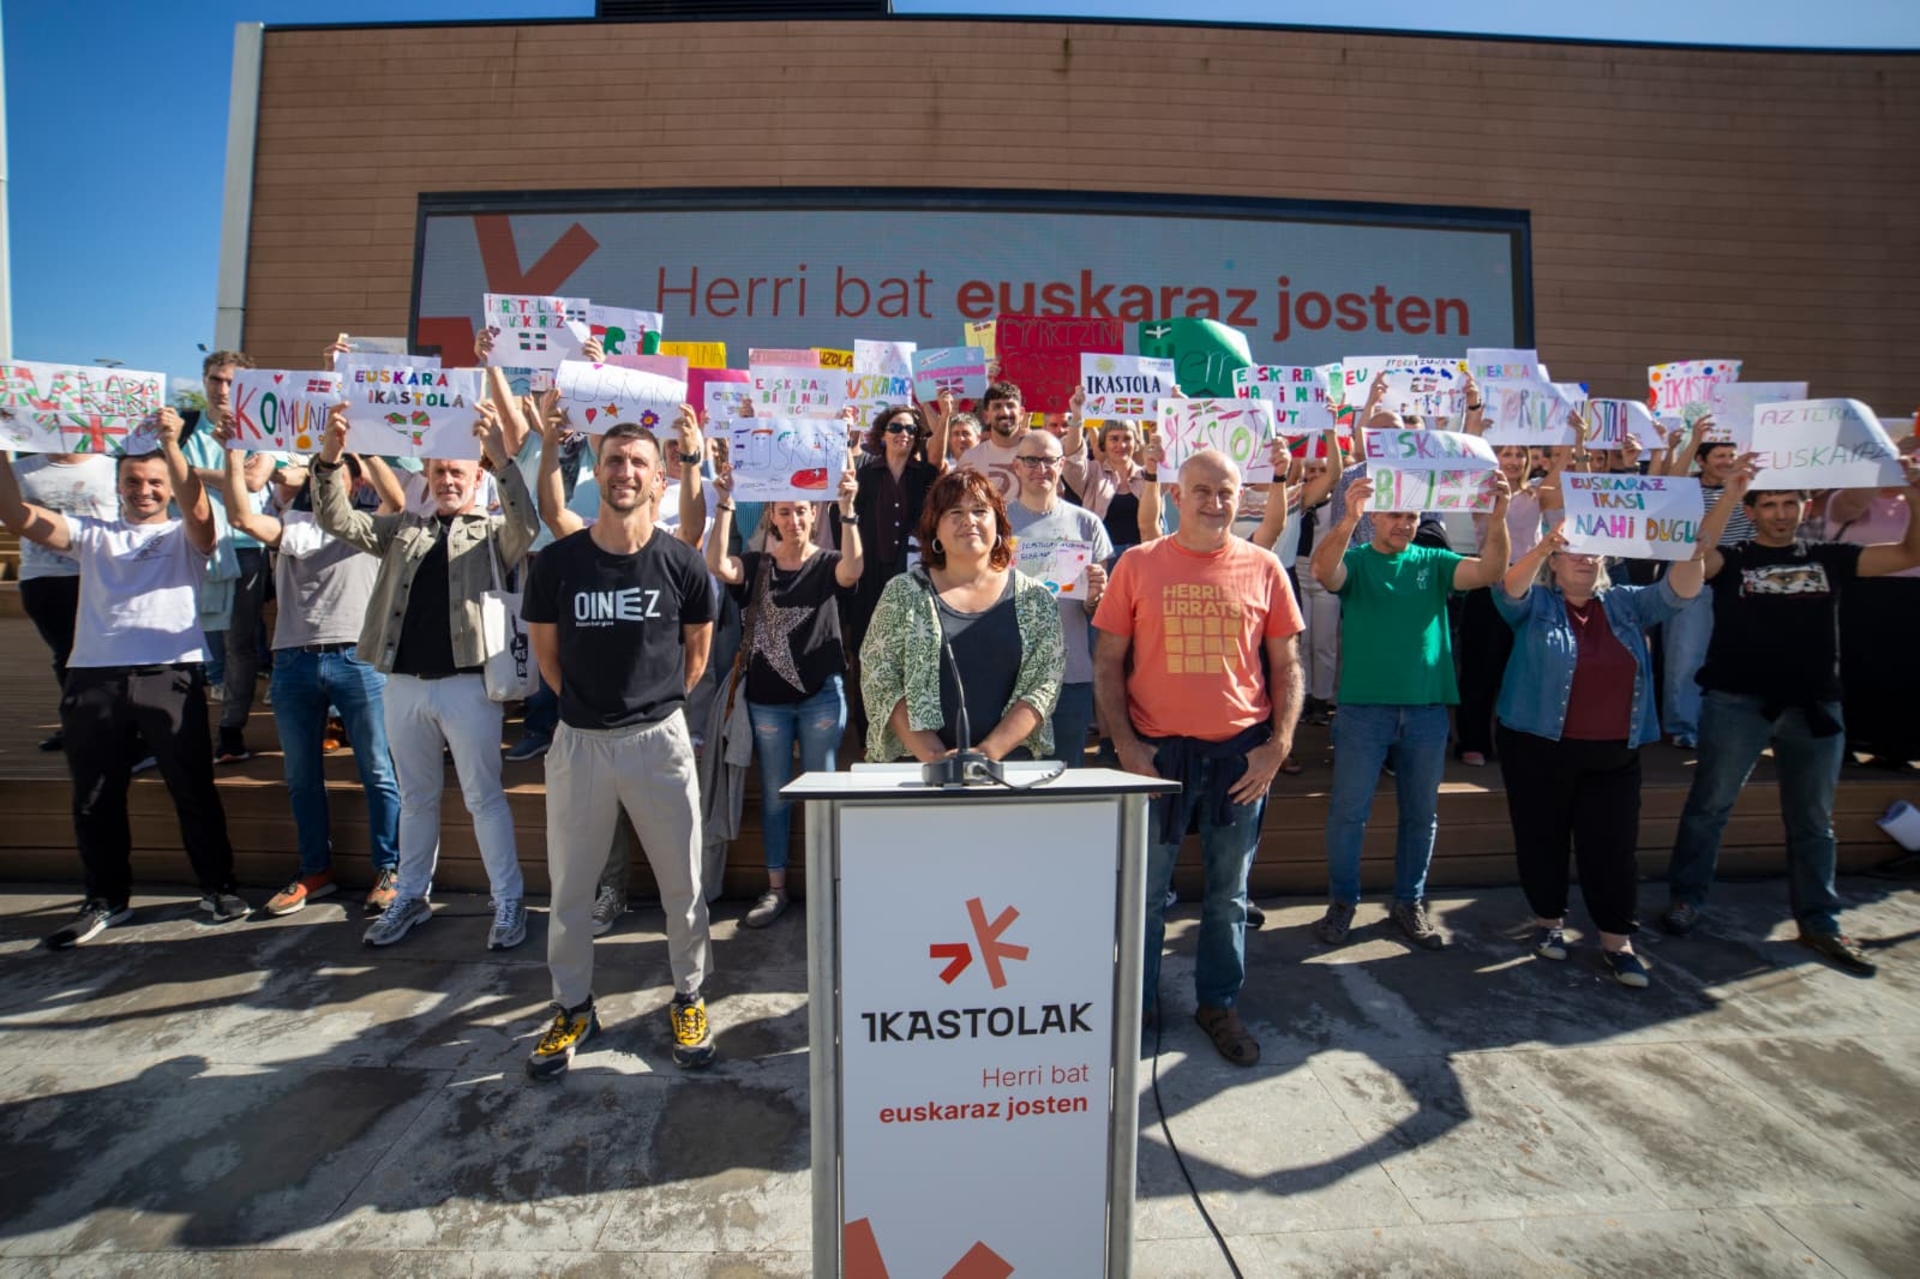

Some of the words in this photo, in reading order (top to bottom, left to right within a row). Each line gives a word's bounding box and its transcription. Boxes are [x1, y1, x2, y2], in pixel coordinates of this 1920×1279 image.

[656, 265, 806, 318] Herri
[836, 265, 933, 318] bat
[956, 268, 1257, 328] euskaraz
[1276, 276, 1469, 343] josten
[355, 370, 449, 387] EUSKARA
[1087, 375, 1161, 394] IKASTOLA
[368, 389, 464, 409] IKASTOLA
[1374, 468, 1435, 510] BIZI
[1571, 478, 1667, 491] EUSKARAZ
[1593, 492, 1644, 510] IKASI
[1575, 514, 1634, 538] NAHI
[1645, 518, 1699, 543] DUGU
[1162, 583, 1221, 599] HERRI
[574, 587, 661, 621] OINEZ
[1162, 600, 1242, 619] URRATS
[982, 1065, 1042, 1088] Herri
[1051, 1064, 1089, 1084] bat
[879, 1099, 1000, 1123] euskaraz
[1006, 1096, 1088, 1121] josten
